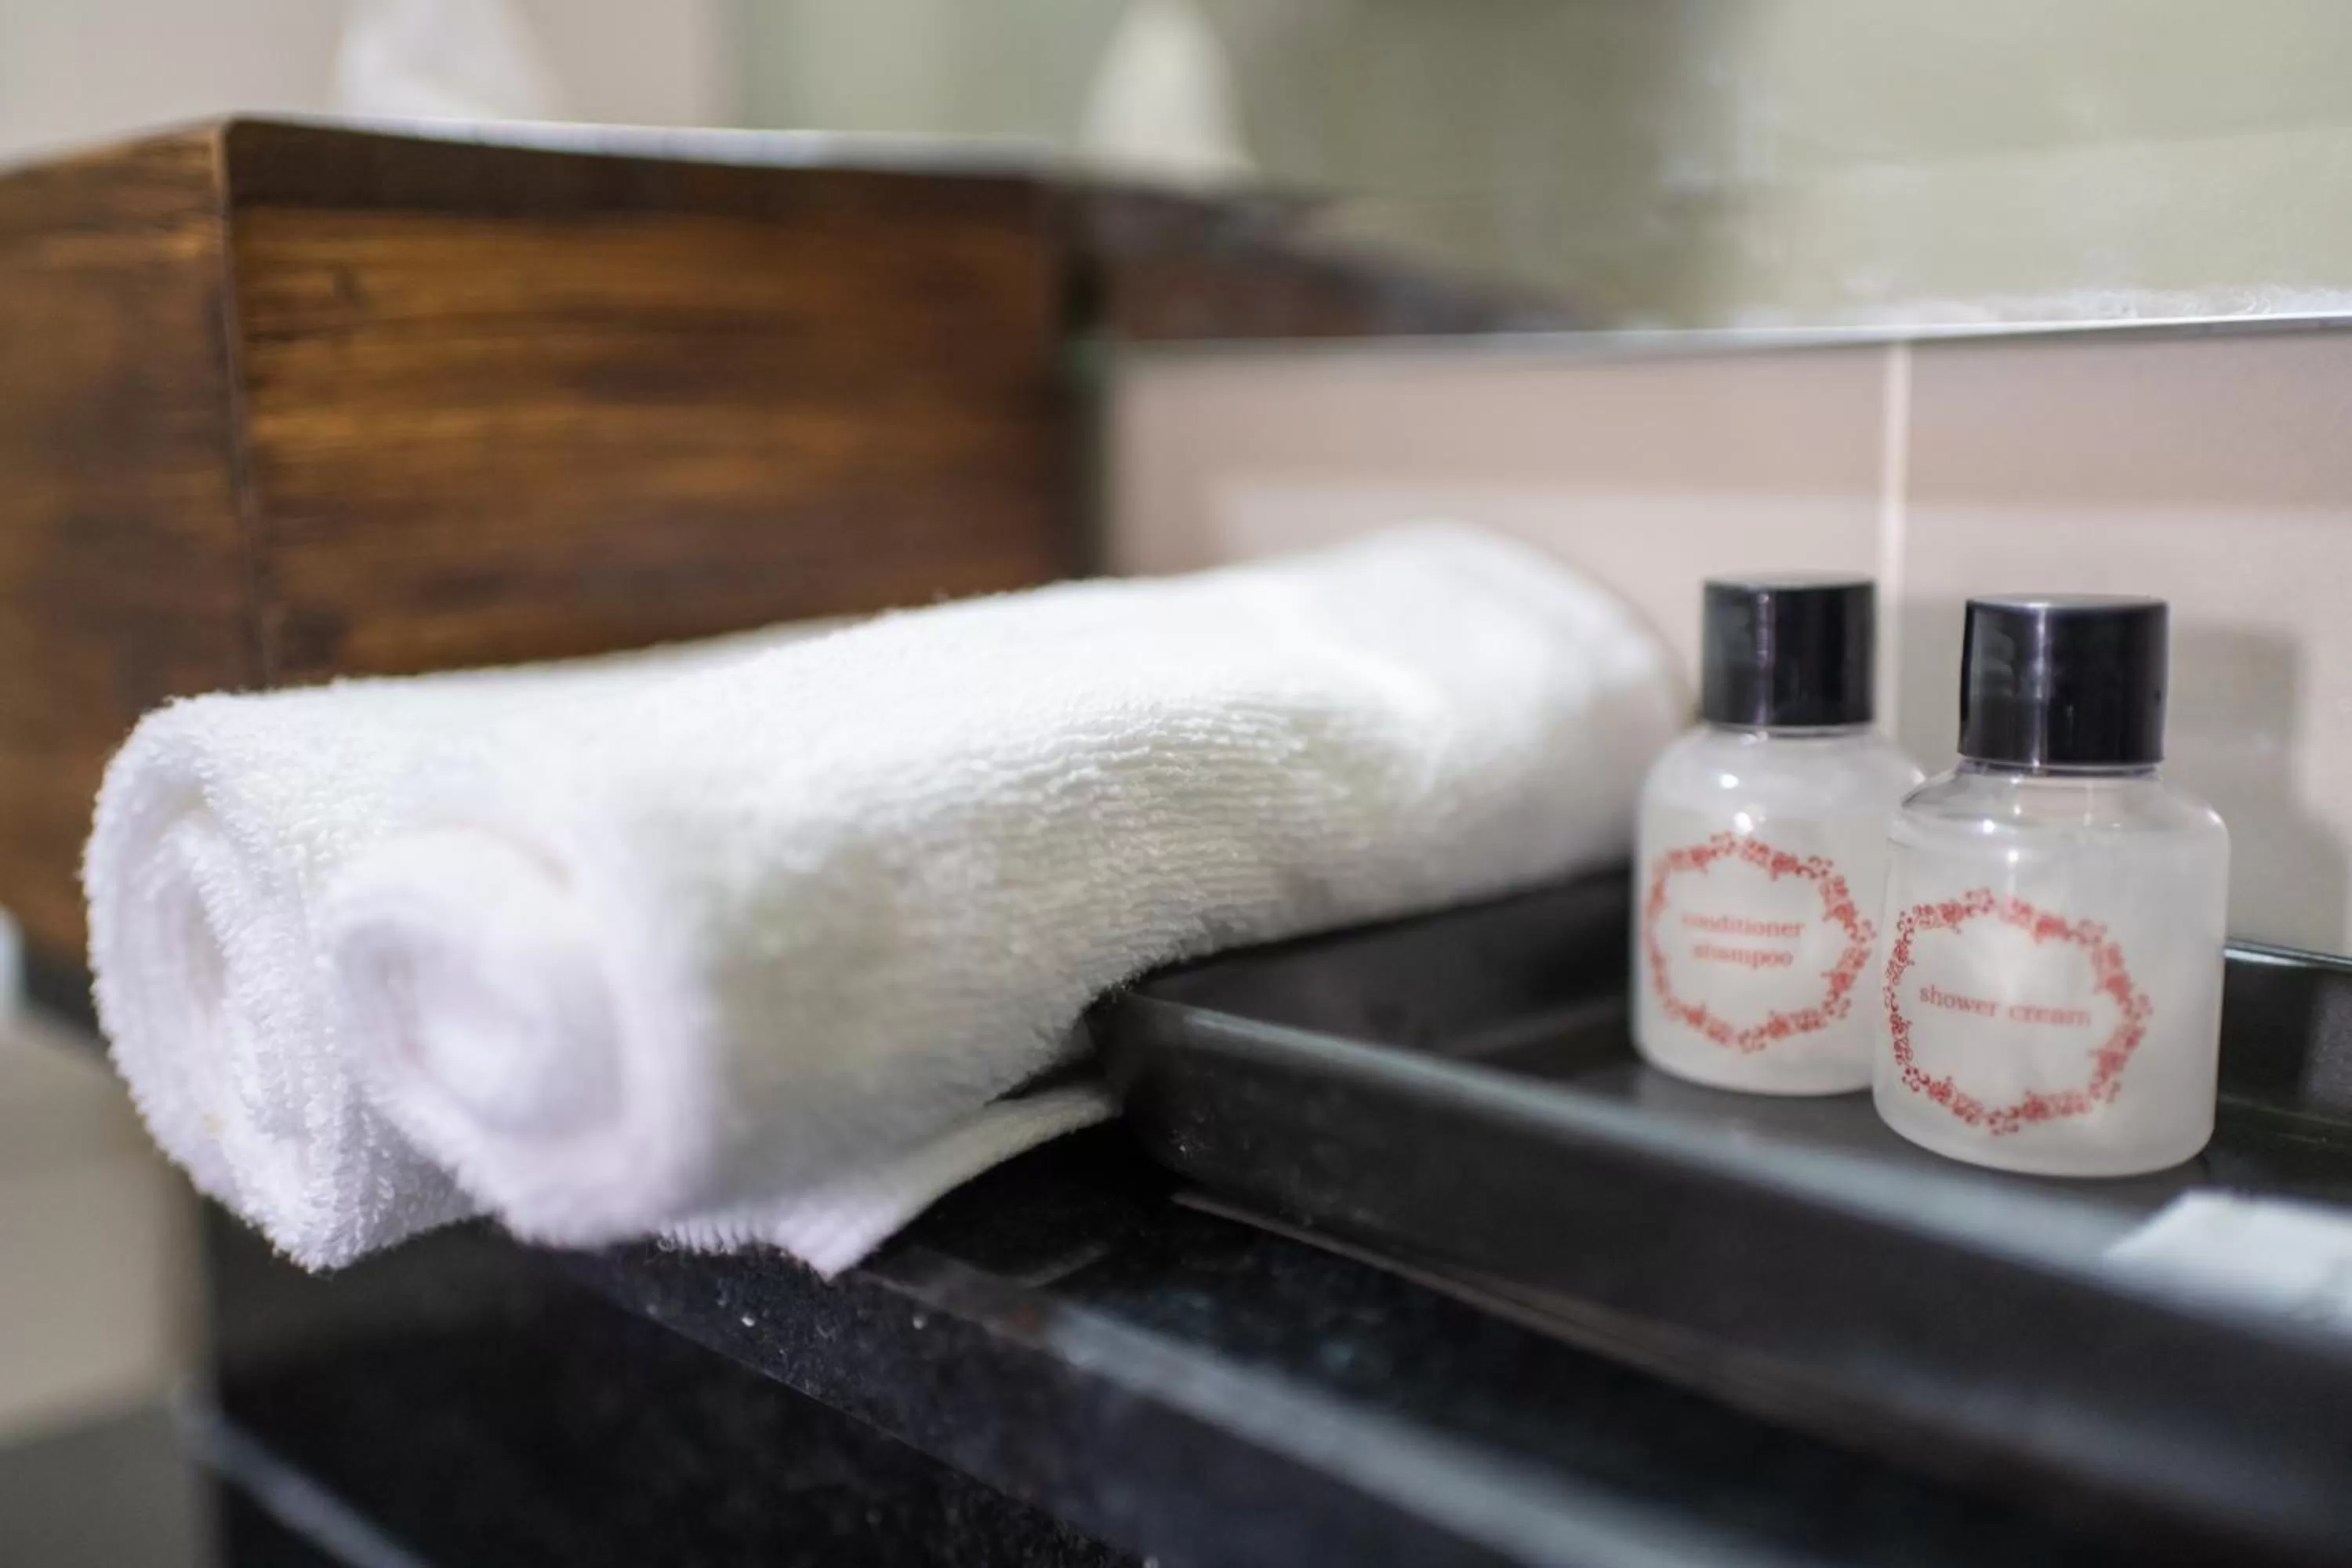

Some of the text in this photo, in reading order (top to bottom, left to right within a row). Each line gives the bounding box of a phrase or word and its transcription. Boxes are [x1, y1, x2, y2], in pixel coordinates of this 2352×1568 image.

[1682, 912, 1806, 938] conditioner
[1919, 984, 2092, 1026] shower cream
